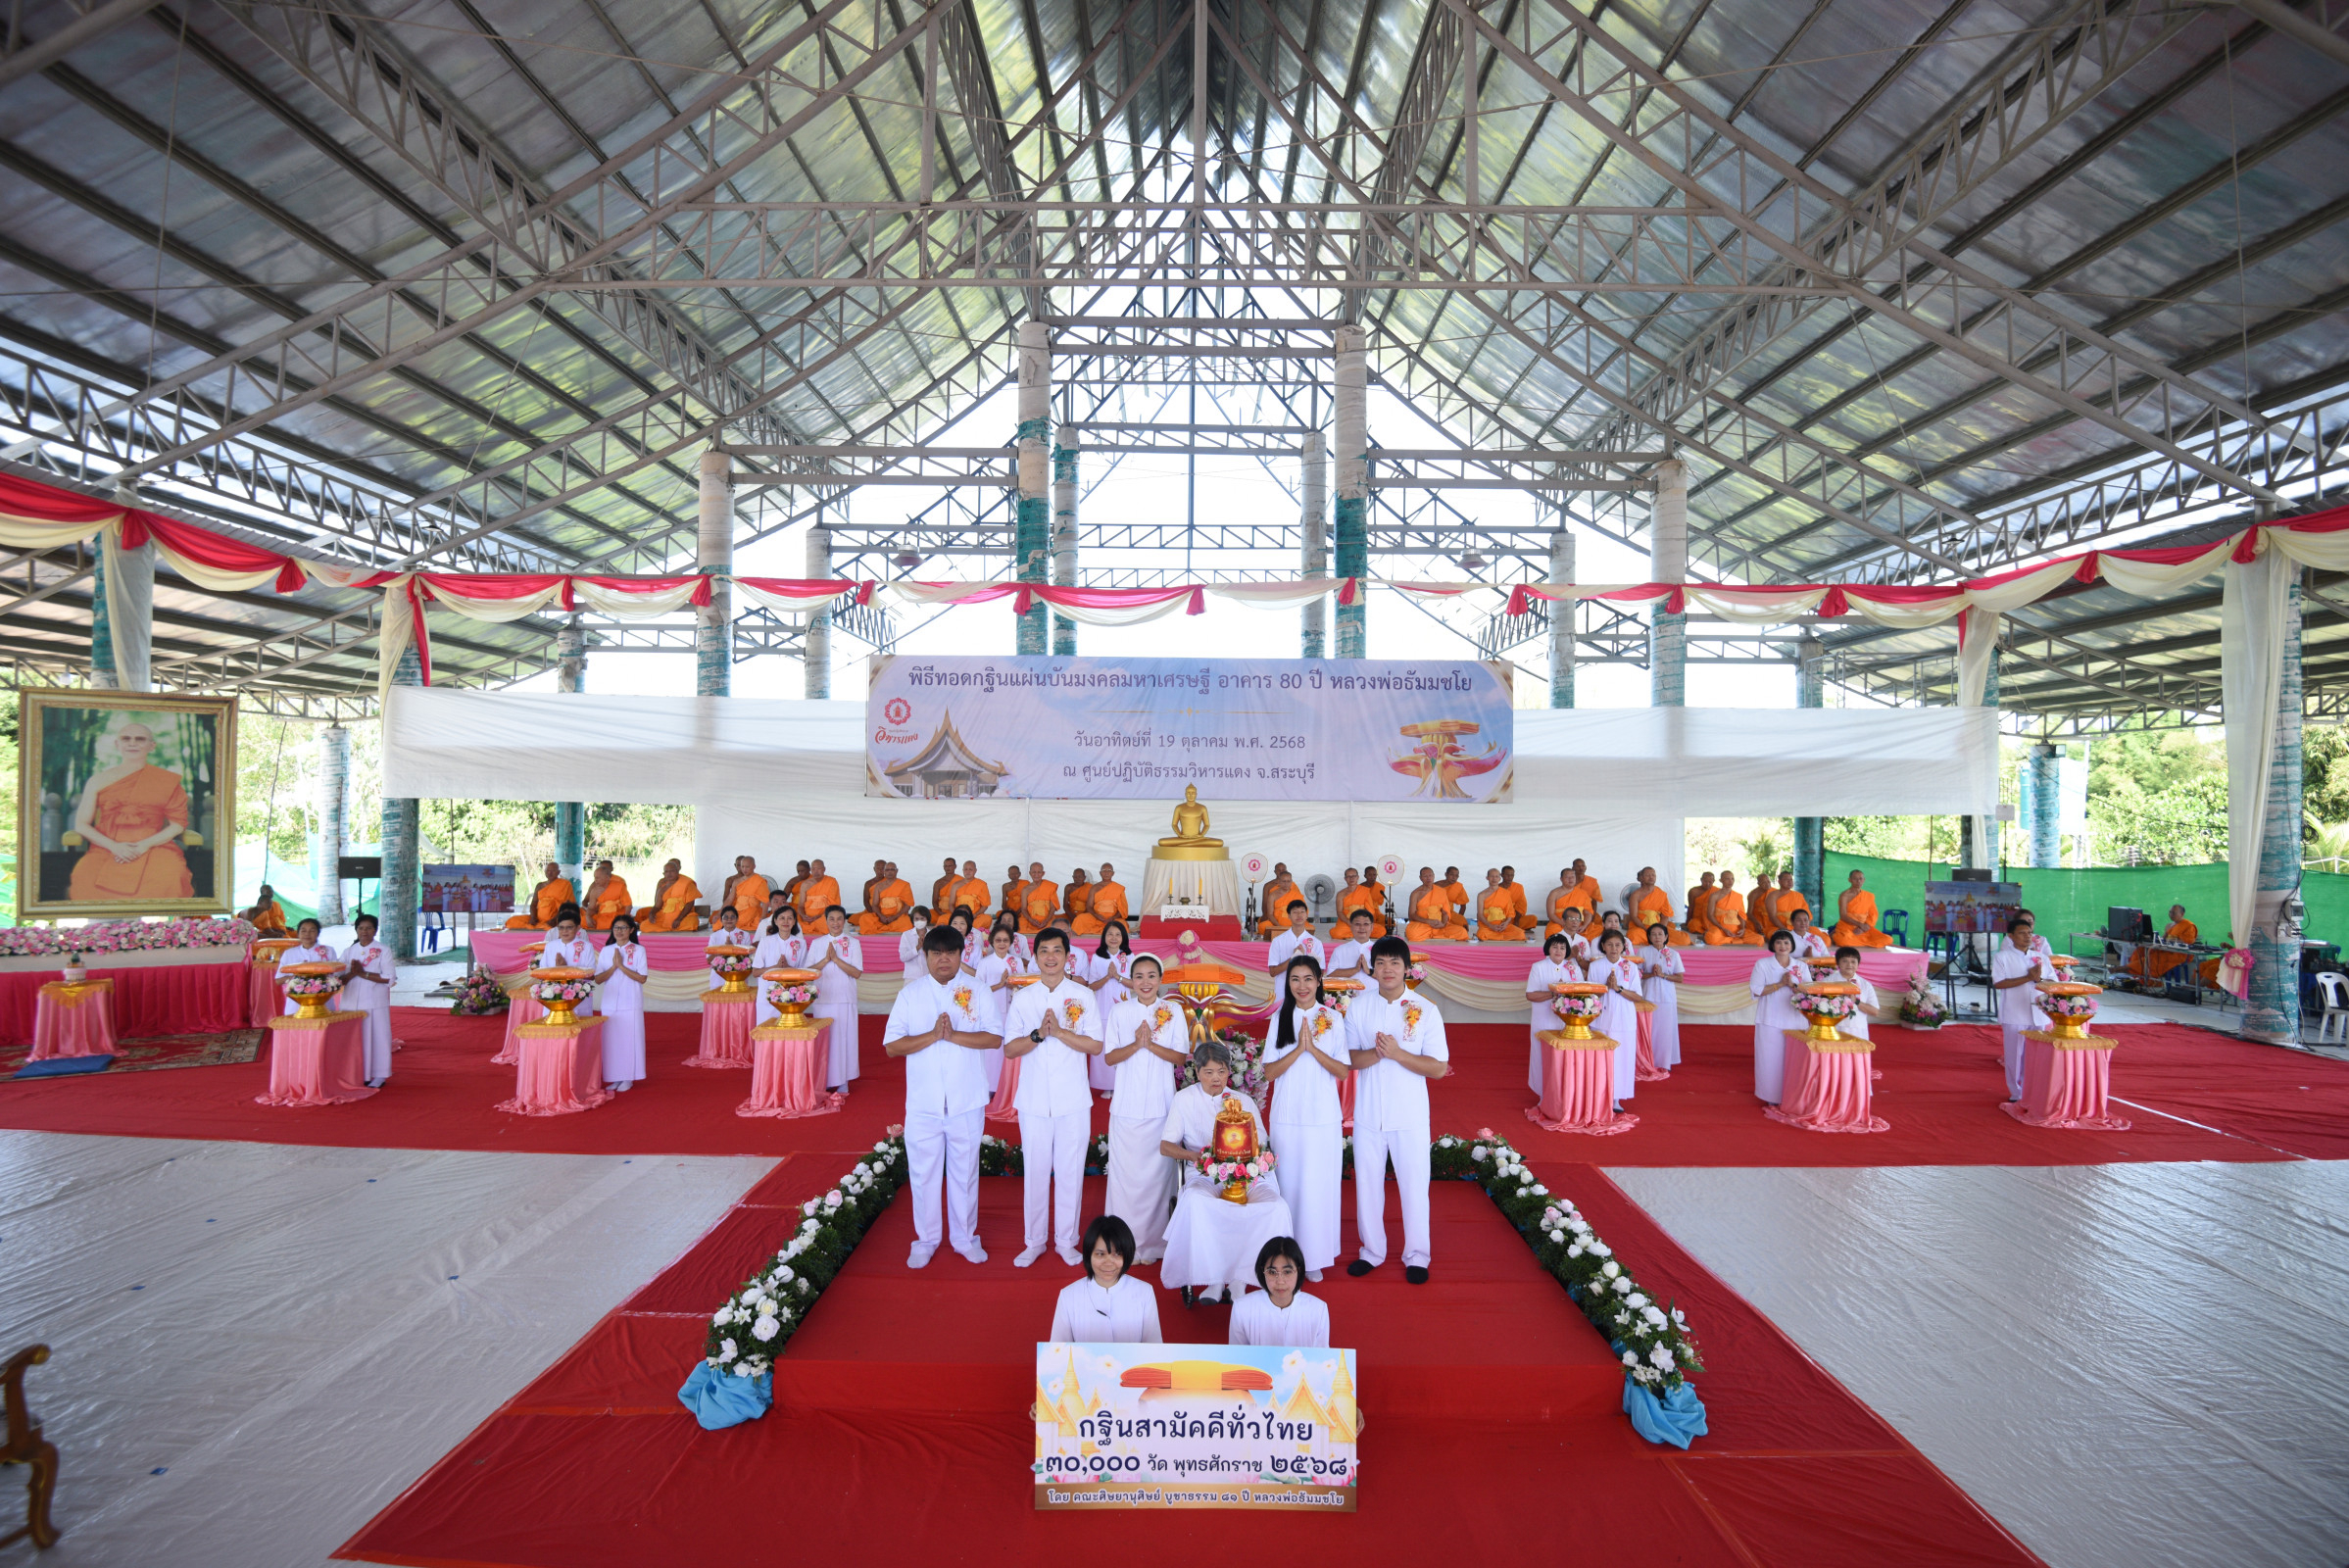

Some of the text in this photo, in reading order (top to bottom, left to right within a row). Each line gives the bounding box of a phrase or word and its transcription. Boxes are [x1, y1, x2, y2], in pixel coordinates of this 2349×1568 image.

[1218, 674, 1272, 689] อาคาร
[1279, 672, 1302, 689] 80
[1309, 668, 1323, 689] ปี
[1330, 670, 1472, 691] หลวงพ่อธัมมชโย
[1074, 727, 1305, 753] วันอาทิตย์ที่ 19 ตุลาคม พ.ศ. 2568
[1063, 760, 1315, 784] ณ ศูนย์ปฏิบัติธรรมวิหารแดง จ.สระบุรี
[1079, 1403, 1313, 1446] กฐินสามัคคีทั่วไทย
[1046, 1453, 1347, 1478] ๓๐,๐๐๐ วัด พุทธศักราช ๒๕๖๘
[1049, 1490, 1070, 1502] โดย
[1073, 1488, 1161, 1504] คณะศิษยานุศิษย์
[1164, 1492, 1217, 1504] บูชาธรรม
[1221, 1493, 1238, 1502] ๘๑
[1242, 1490, 1250, 1501] ปี
